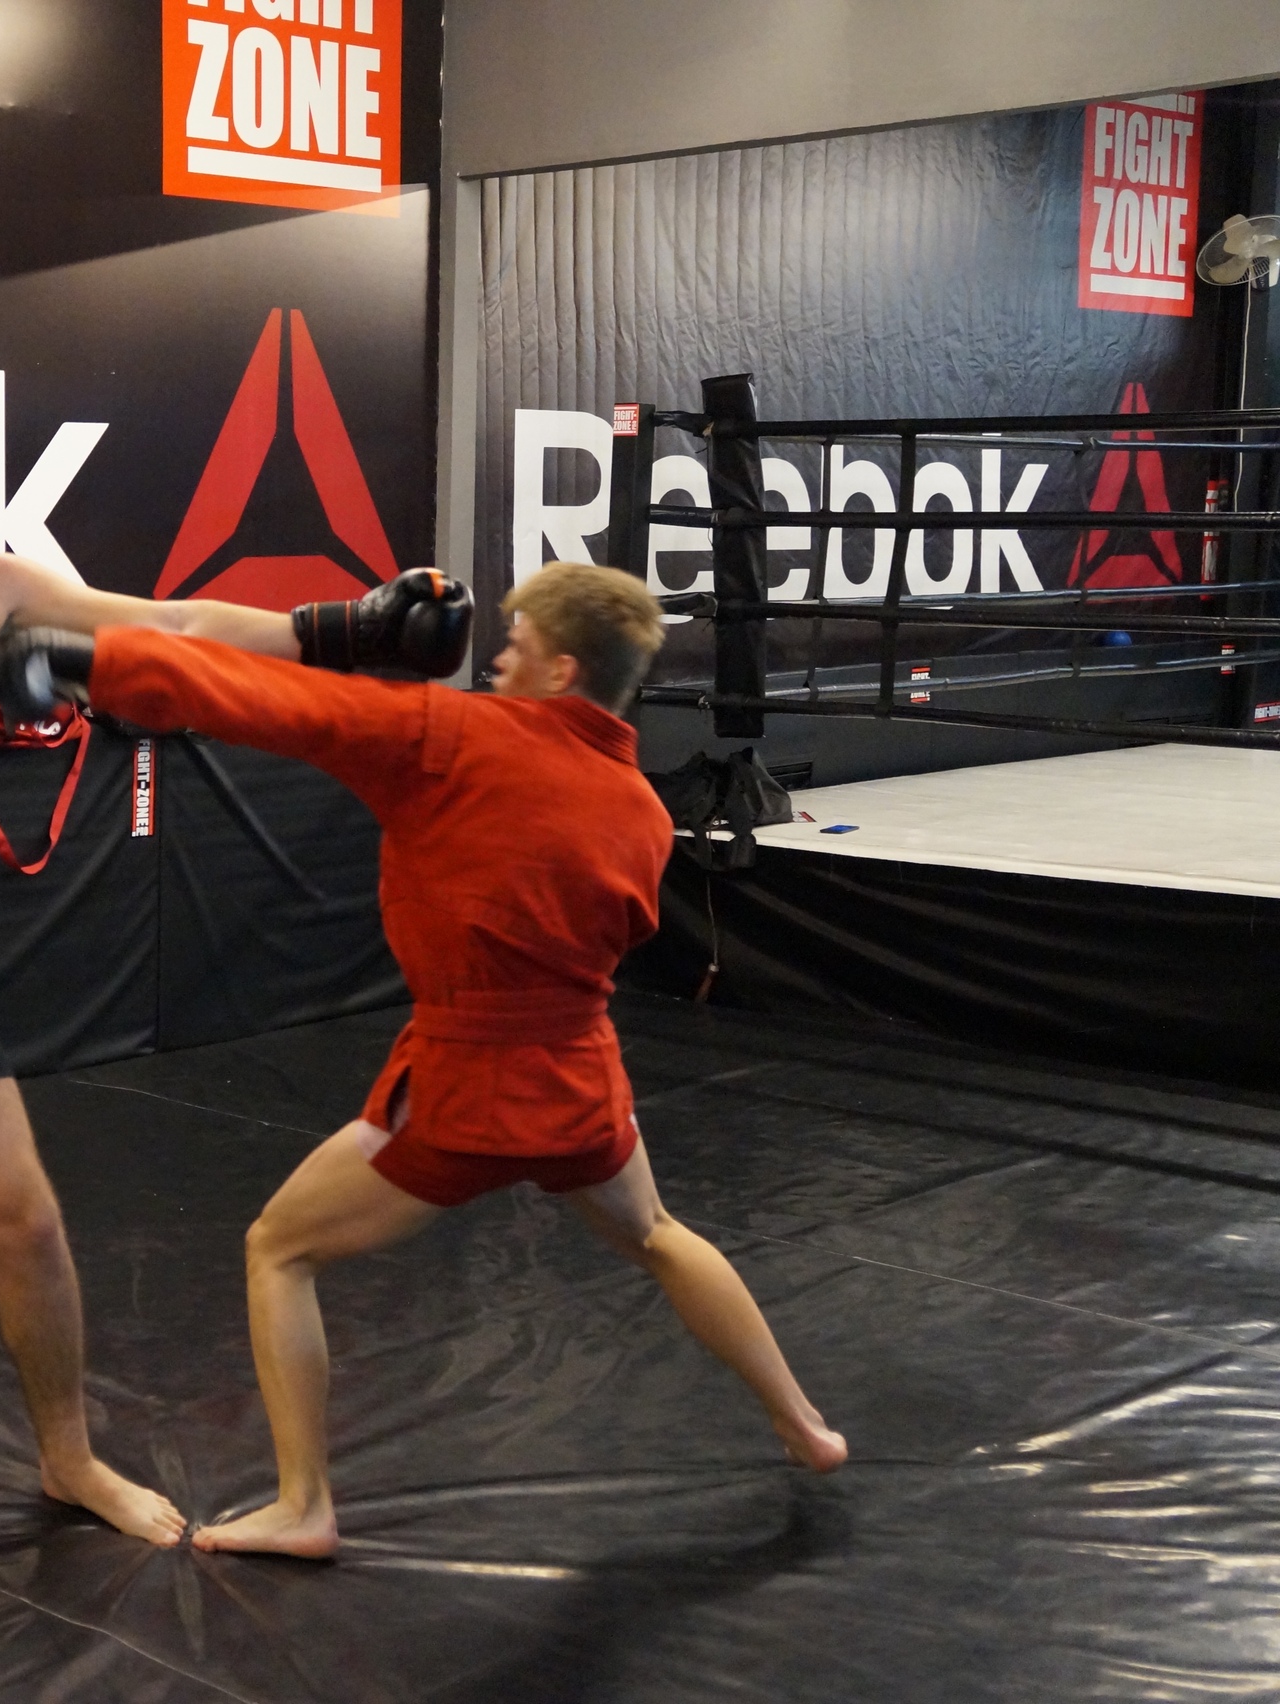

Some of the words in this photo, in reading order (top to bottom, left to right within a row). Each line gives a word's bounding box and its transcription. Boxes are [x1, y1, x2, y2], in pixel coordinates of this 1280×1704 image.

[186, 18, 381, 160] ZONE
[1094, 106, 1194, 188] FIGHT
[1090, 186, 1188, 277] ZONE
